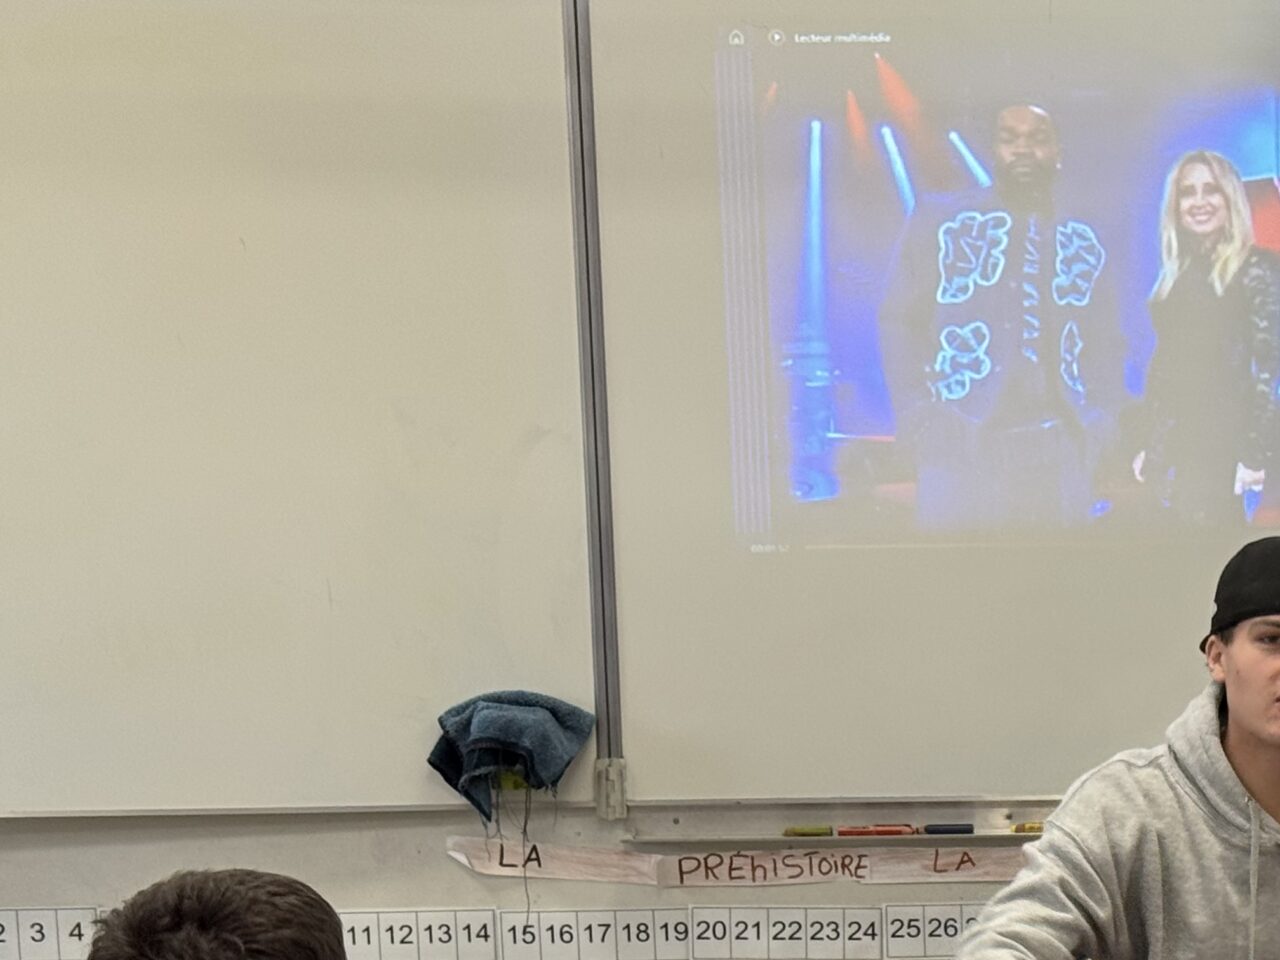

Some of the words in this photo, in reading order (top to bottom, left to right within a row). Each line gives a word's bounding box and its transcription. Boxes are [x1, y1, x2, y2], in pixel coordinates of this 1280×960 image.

[498, 844, 543, 869] LA
[934, 848, 976, 873] LA
[31, 923, 45, 942] 3
[69, 922, 84, 940] 4
[348, 926, 370, 945] 11
[386, 925, 413, 944] 12
[425, 924, 452, 943] 13
[463, 924, 490, 942] 14
[508, 925, 535, 944] 15
[547, 924, 573, 943] 16
[585, 924, 611, 942] 17
[623, 923, 649, 942] 18
[660, 922, 688, 941] 19
[697, 921, 726, 940] 20
[735, 921, 760, 940] 21
[773, 921, 802, 940] 22
[810, 921, 840, 940] 23
[848, 922, 877, 940] 24
[891, 919, 920, 938] 25
[928, 918, 958, 937] 26
